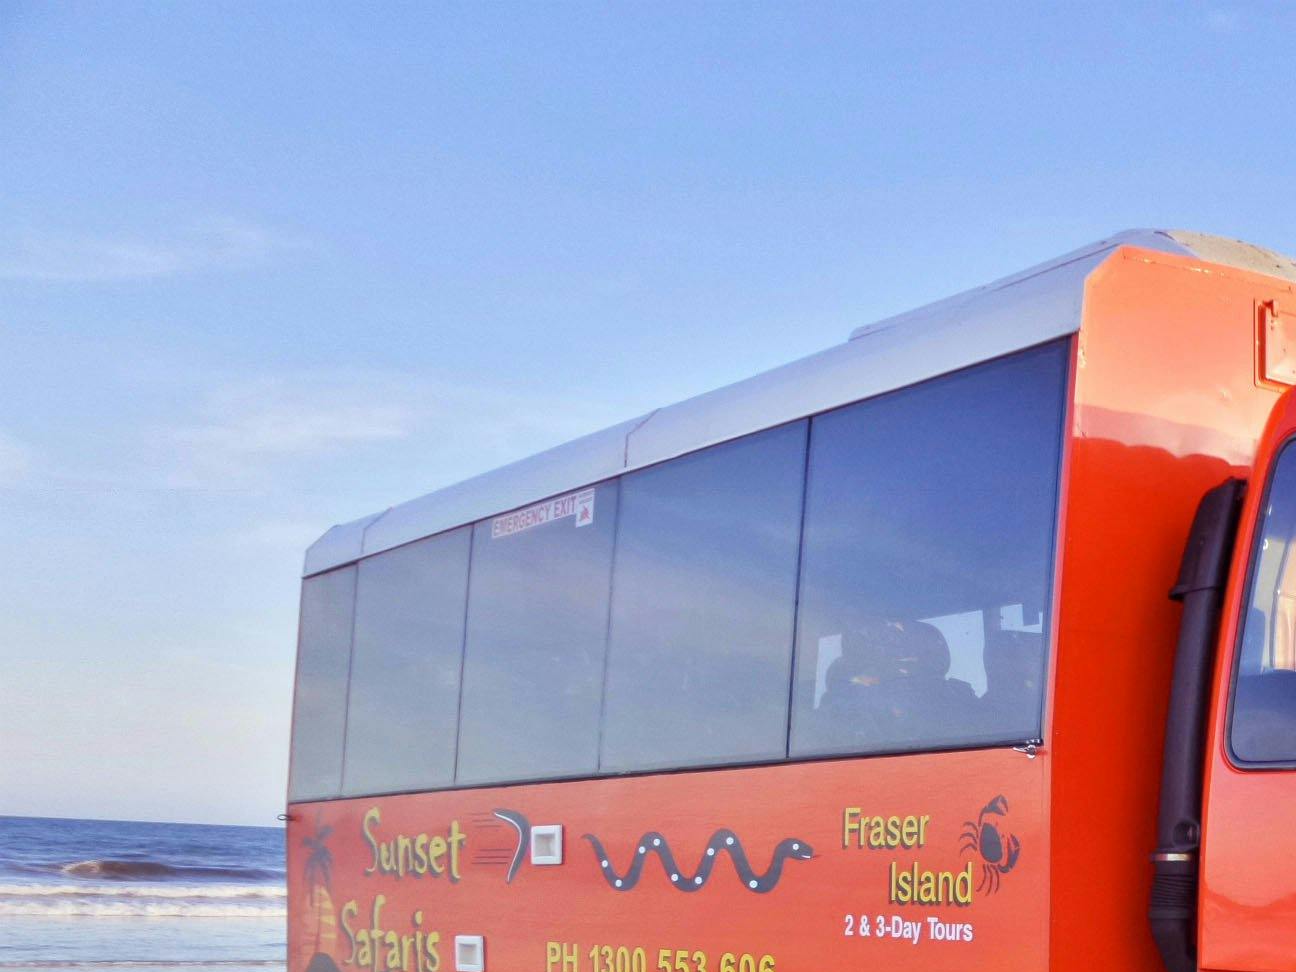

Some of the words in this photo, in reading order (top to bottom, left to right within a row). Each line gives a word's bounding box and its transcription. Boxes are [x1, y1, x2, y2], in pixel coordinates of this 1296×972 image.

[494, 504, 551, 532] EMERGENCY
[554, 495, 577, 518] EXIT
[363, 806, 466, 882] Sunset
[843, 807, 930, 848] Fraser
[889, 861, 973, 906] Island
[844, 915, 854, 937] 2
[860, 915, 870, 937] &
[876, 916, 921, 944] 3-Day
[927, 917, 973, 942] Tours
